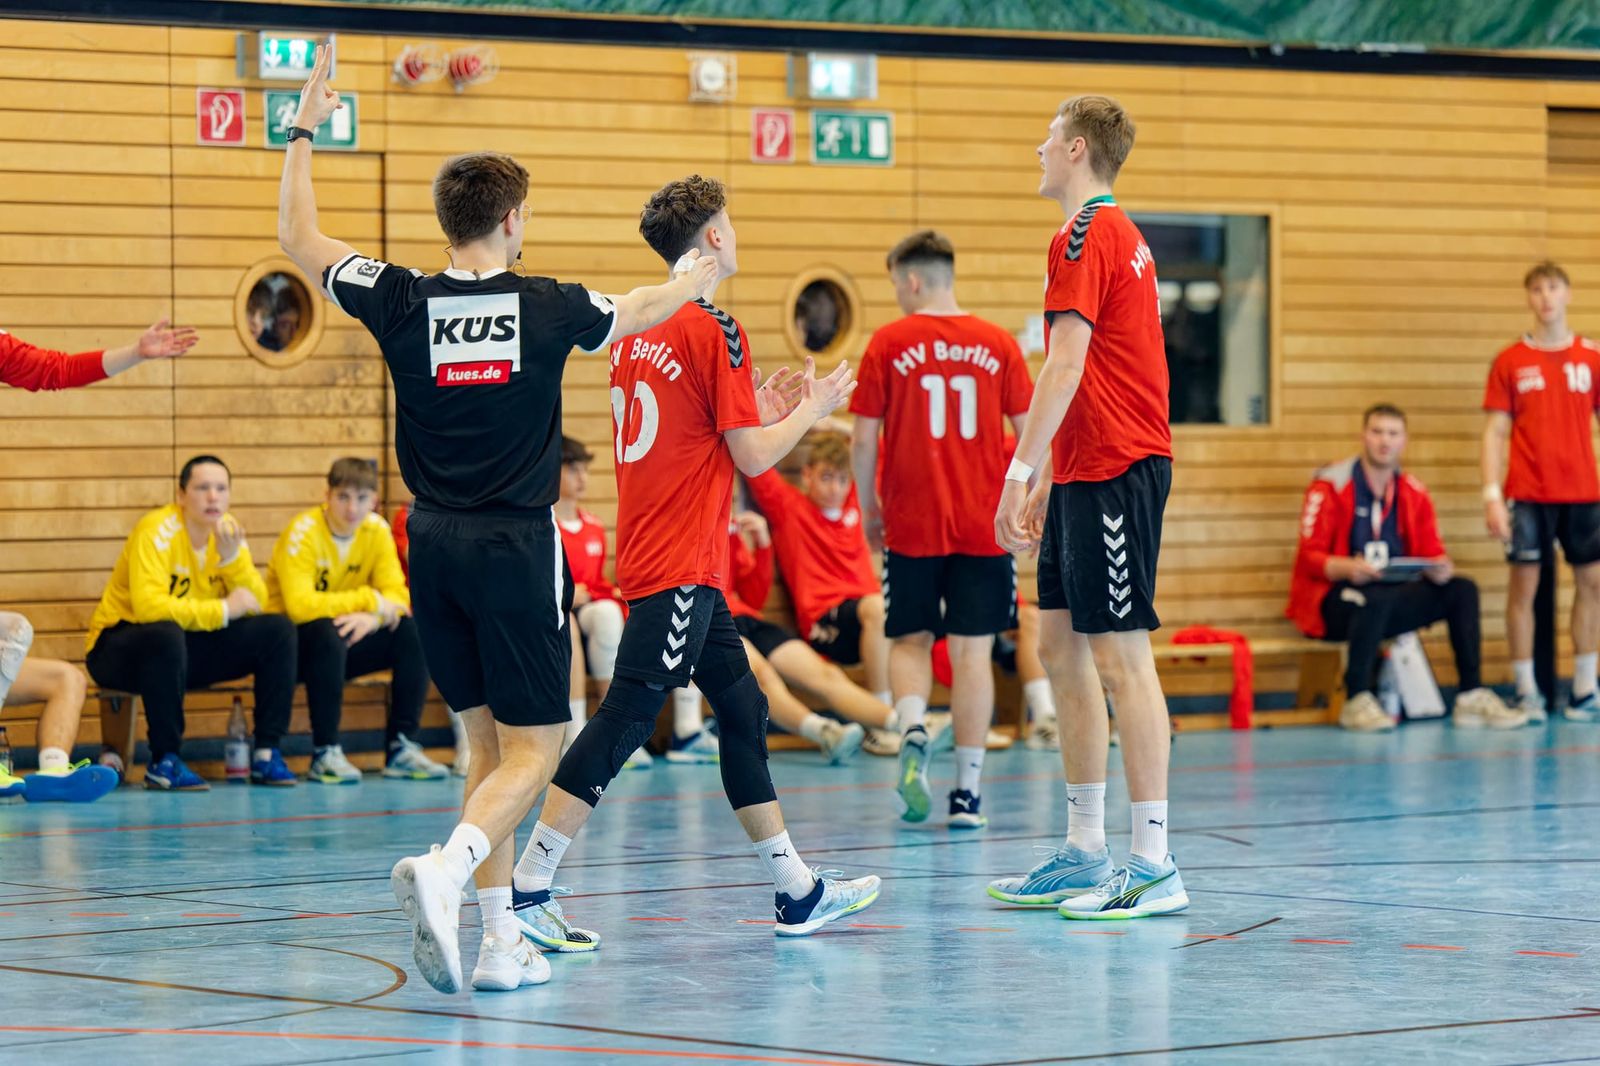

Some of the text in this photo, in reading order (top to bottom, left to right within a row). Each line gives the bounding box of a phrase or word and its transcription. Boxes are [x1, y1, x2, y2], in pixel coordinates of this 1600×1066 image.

[432, 314, 516, 345] KÜS
[446, 365, 502, 382] kues.de
[630, 337, 682, 382] Berlin
[892, 339, 1000, 377] HV Berlin
[920, 373, 977, 440] 11
